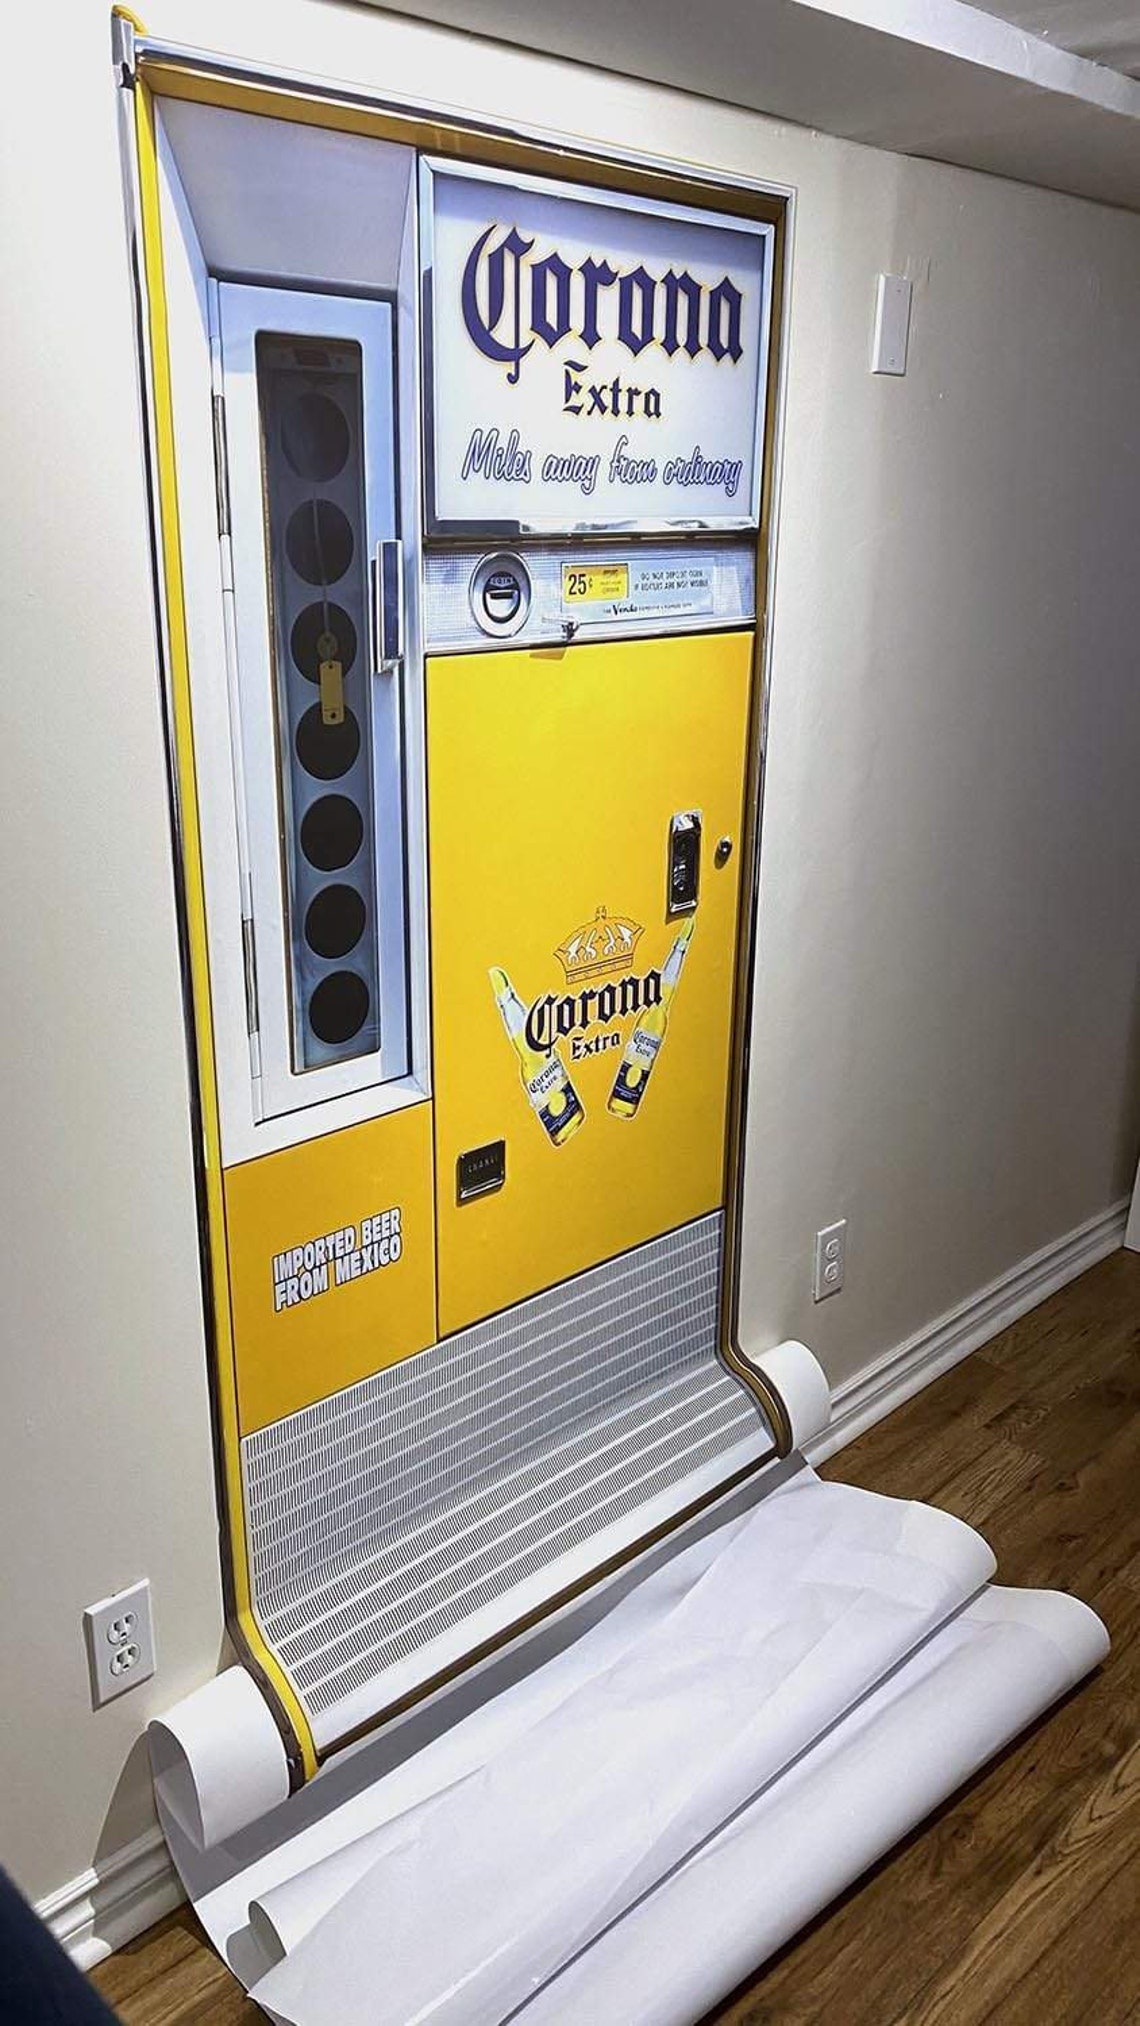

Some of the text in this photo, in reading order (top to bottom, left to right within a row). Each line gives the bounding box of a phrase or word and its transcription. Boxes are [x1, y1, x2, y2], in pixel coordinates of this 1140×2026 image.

[461, 222, 744, 385] Corona
[562, 360, 662, 419] Extra
[462, 428, 743, 497] Miles away from ordinary
[525, 969, 662, 1058] Corona
[571, 1033, 620, 1060] Extra
[529, 1060, 560, 1093] Corona
[273, 1206, 402, 1284] IMPORTED BEER
[274, 1234, 402, 1313] FROM MEXICO
